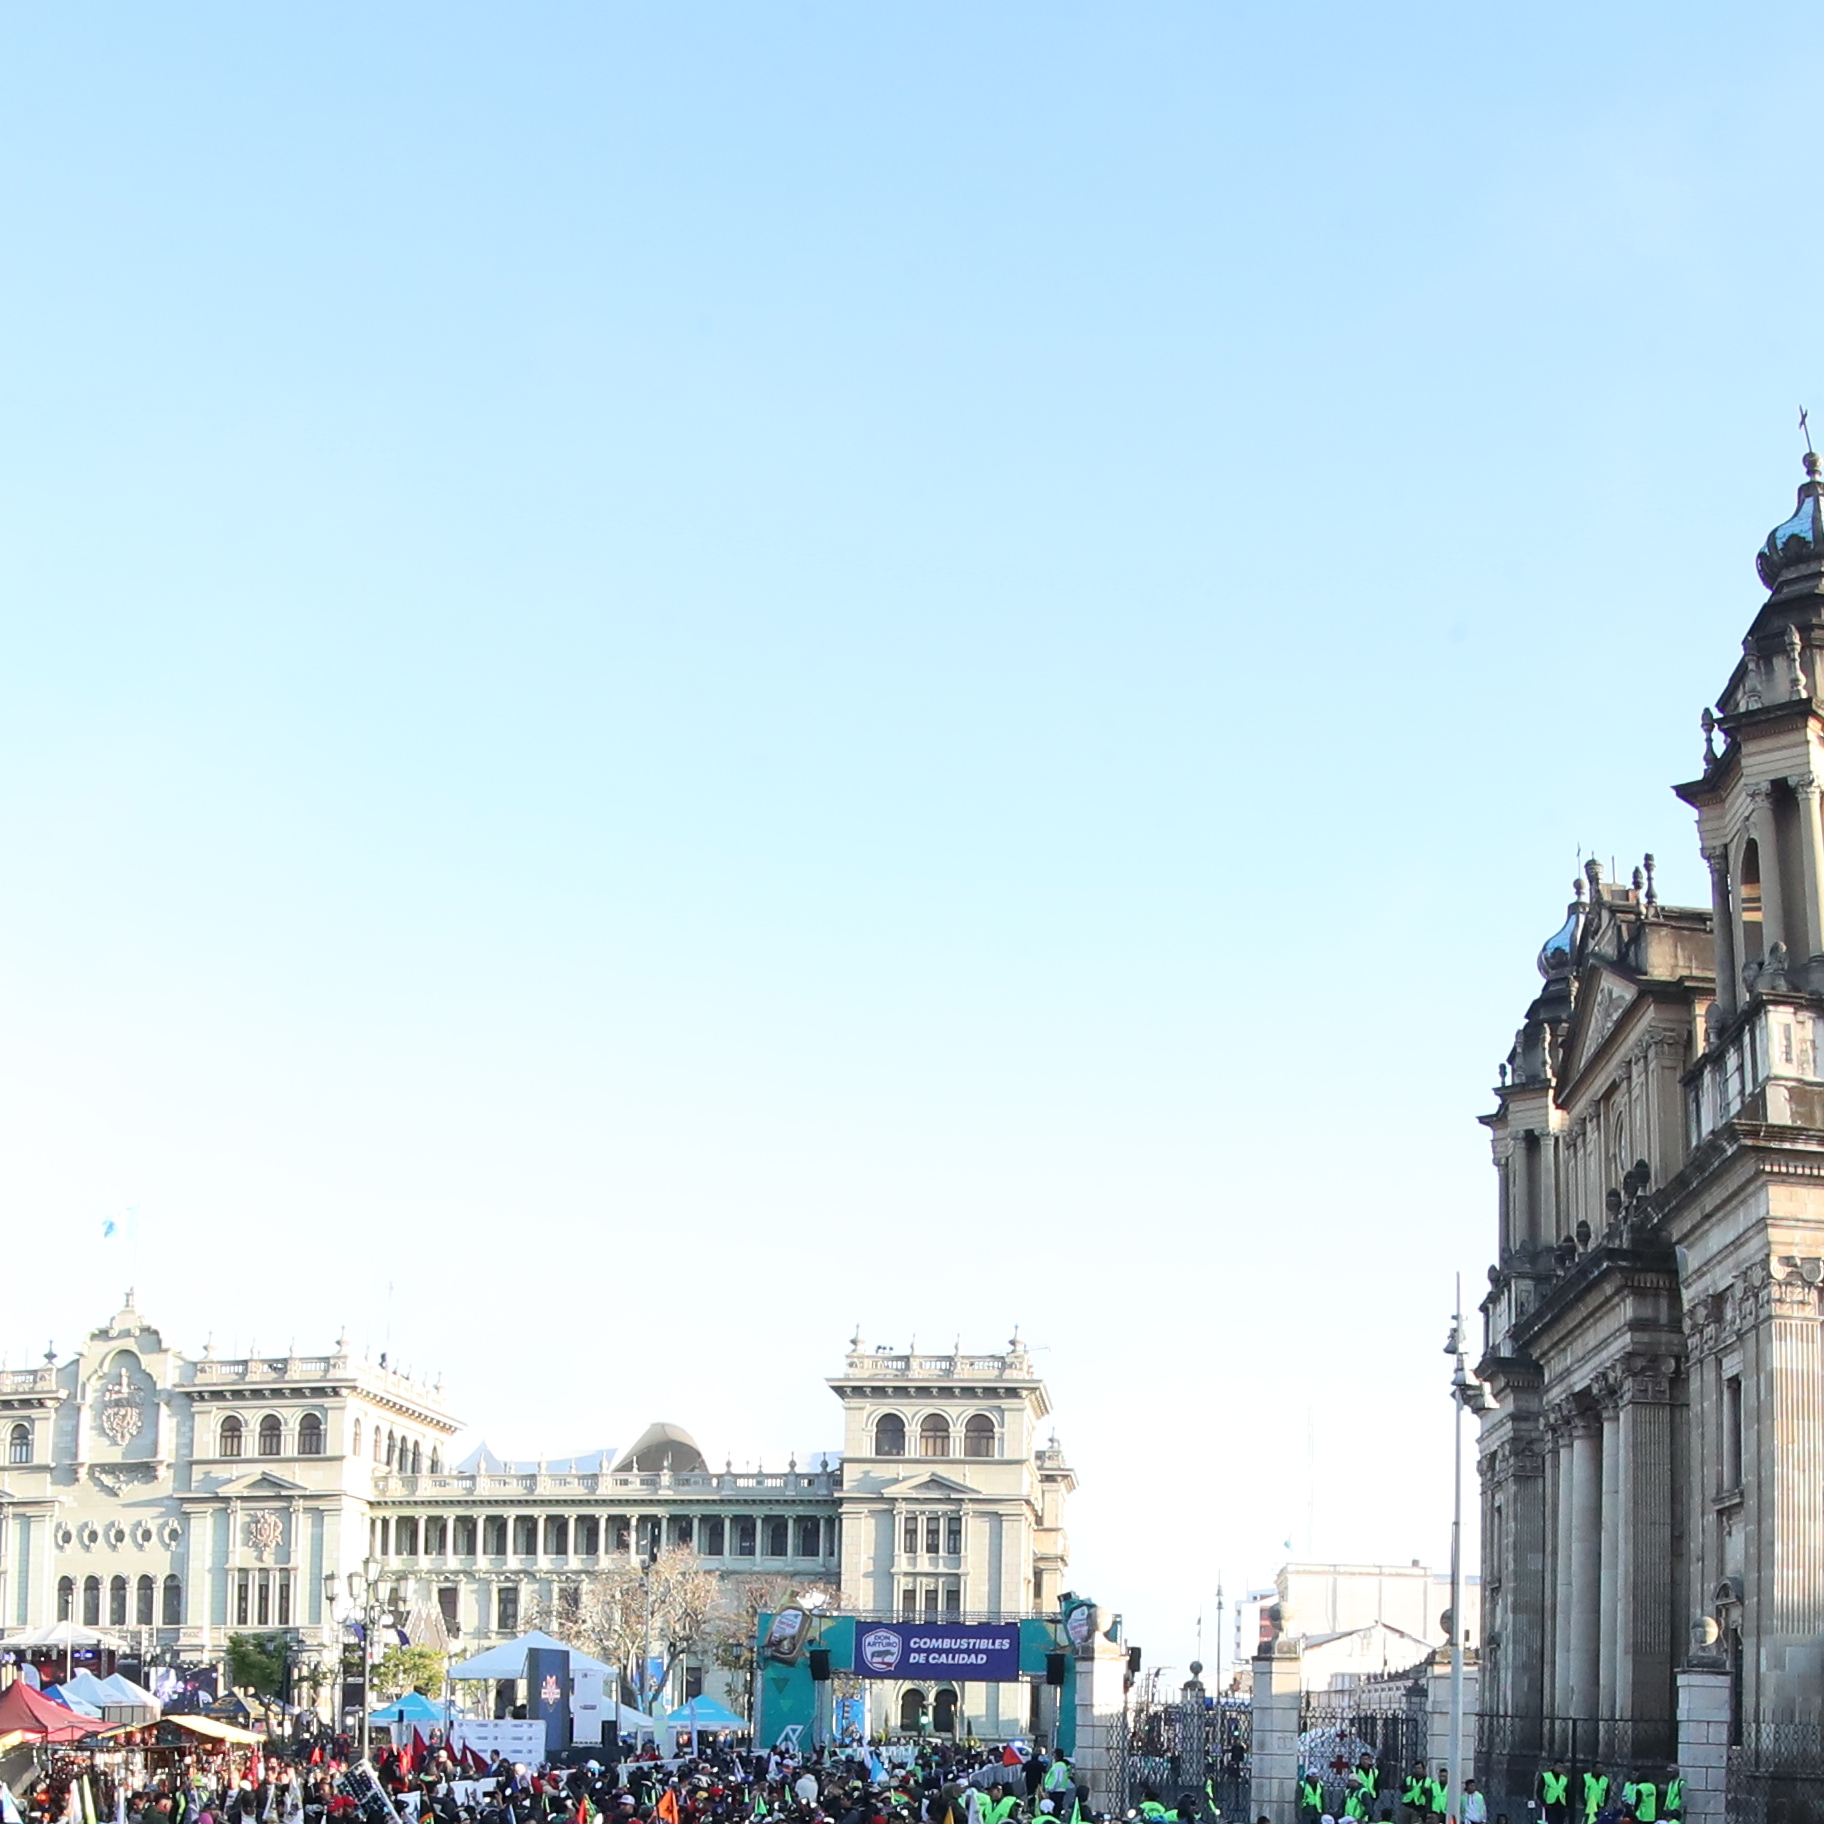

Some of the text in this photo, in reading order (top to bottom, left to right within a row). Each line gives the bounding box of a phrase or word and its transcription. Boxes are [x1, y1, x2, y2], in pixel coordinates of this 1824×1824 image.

[873, 1634, 891, 1642] DON
[866, 1641, 898, 1649] ARTURO
[909, 1637, 1011, 1650] COMBUSTIBLES
[909, 1653, 988, 1665] DE CALIDAD
